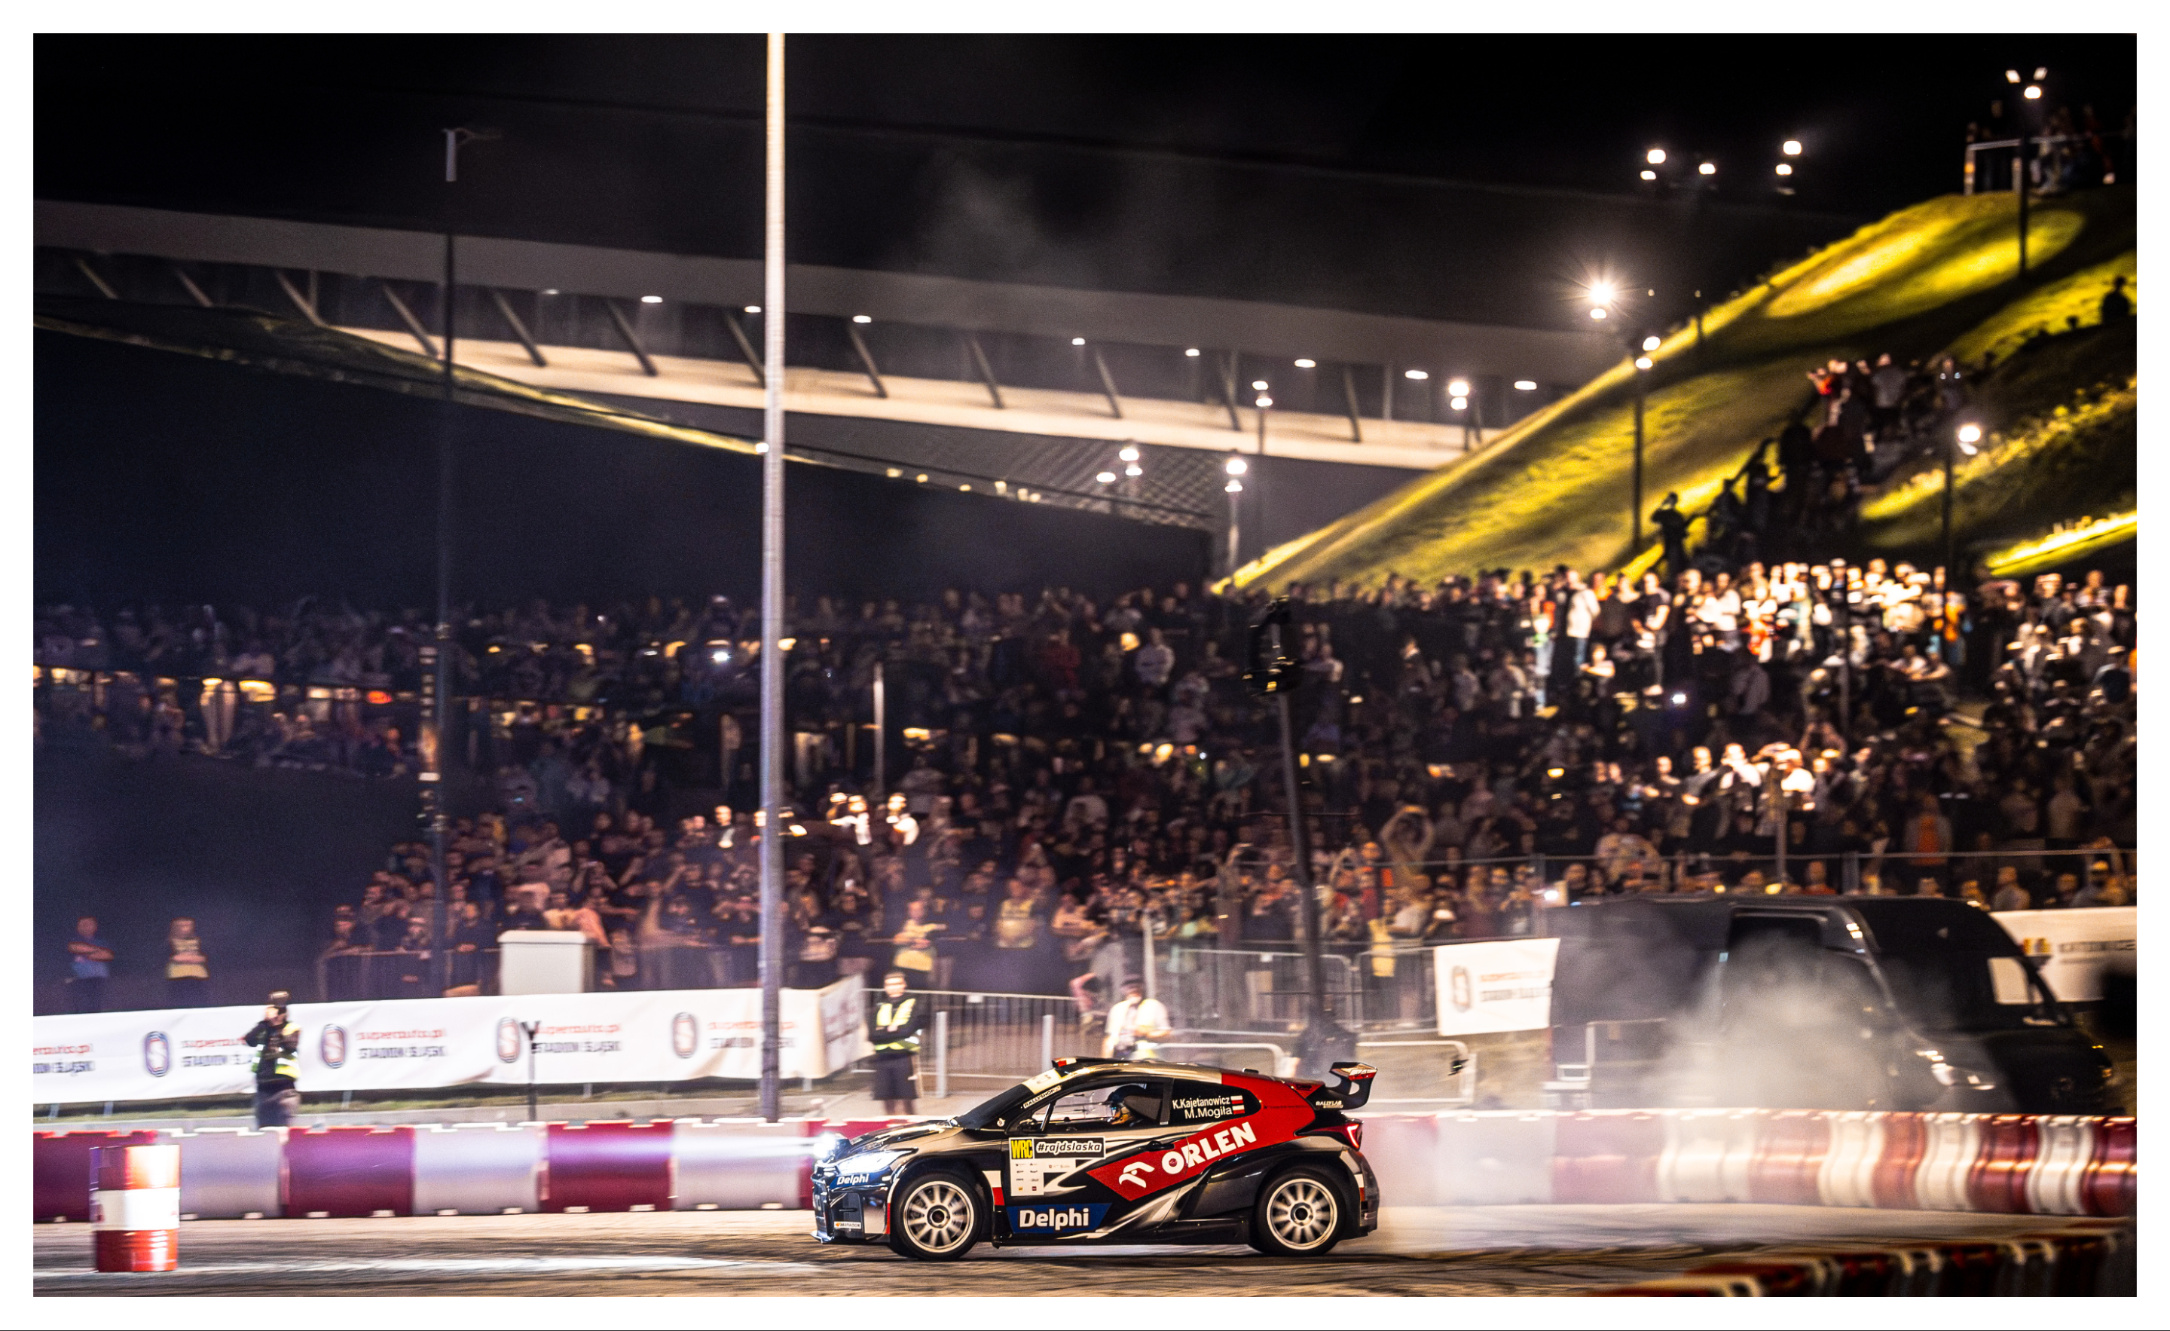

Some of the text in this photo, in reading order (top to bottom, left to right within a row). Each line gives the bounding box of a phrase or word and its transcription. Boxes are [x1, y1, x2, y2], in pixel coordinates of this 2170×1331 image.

[1172, 1095, 1230, 1110] K.Kajetanowicz
[1184, 1106, 1232, 1119] M.Mogiła
[1010, 1139, 1102, 1159] WRC #rajdslaska
[1161, 1121, 1257, 1175] ORLEN
[836, 1173, 869, 1185] Delphi
[1019, 1207, 1089, 1231] Delphi
